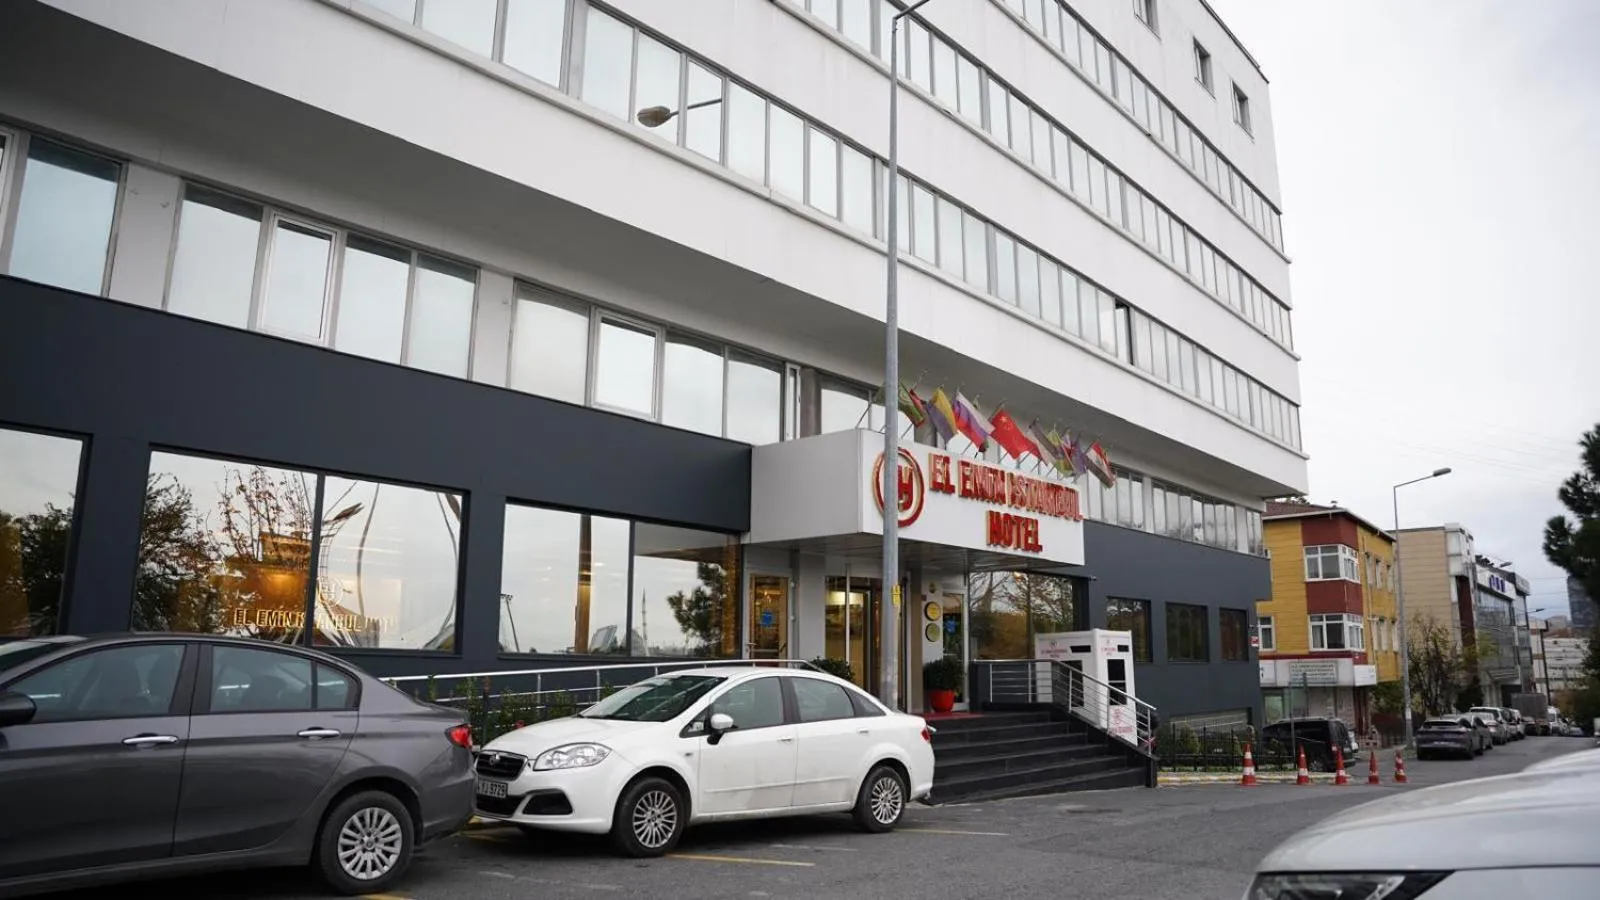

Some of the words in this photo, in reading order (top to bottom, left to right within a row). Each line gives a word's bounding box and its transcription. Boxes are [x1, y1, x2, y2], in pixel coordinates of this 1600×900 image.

[929, 452, 955, 494] EL
[986, 510, 1043, 553] HOTEL
[235, 608, 251, 626] EL
